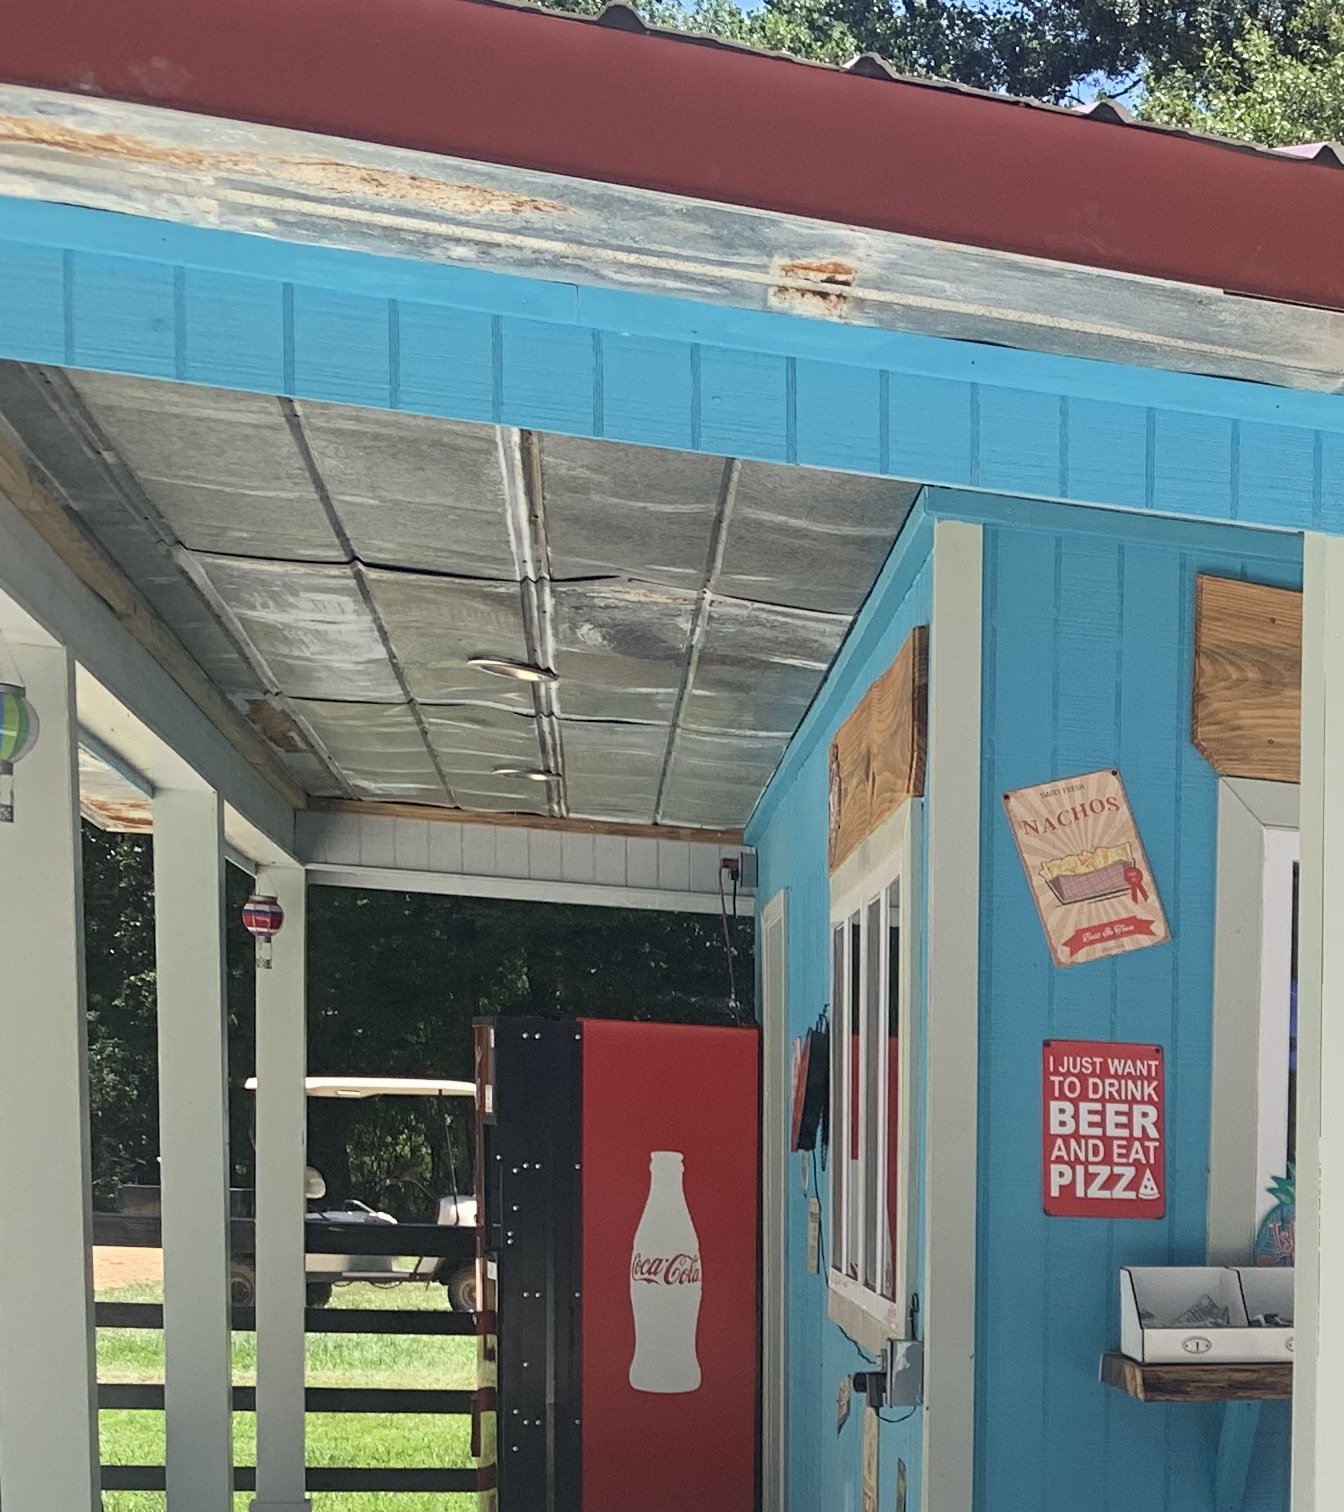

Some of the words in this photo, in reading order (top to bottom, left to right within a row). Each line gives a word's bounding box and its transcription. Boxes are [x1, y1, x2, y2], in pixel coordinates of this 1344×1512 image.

[1022, 796, 1121, 835] NACHOS
[1050, 1055, 1054, 1073] I
[1058, 1056, 1104, 1075] JUST
[1108, 1058, 1160, 1077] WANT
[1050, 1076, 1081, 1098] TO
[1088, 1077, 1159, 1102] DRINK
[1050, 1100, 1160, 1139] BEER
[1050, 1138, 1105, 1162] AND
[1112, 1139, 1160, 1164] EAT
